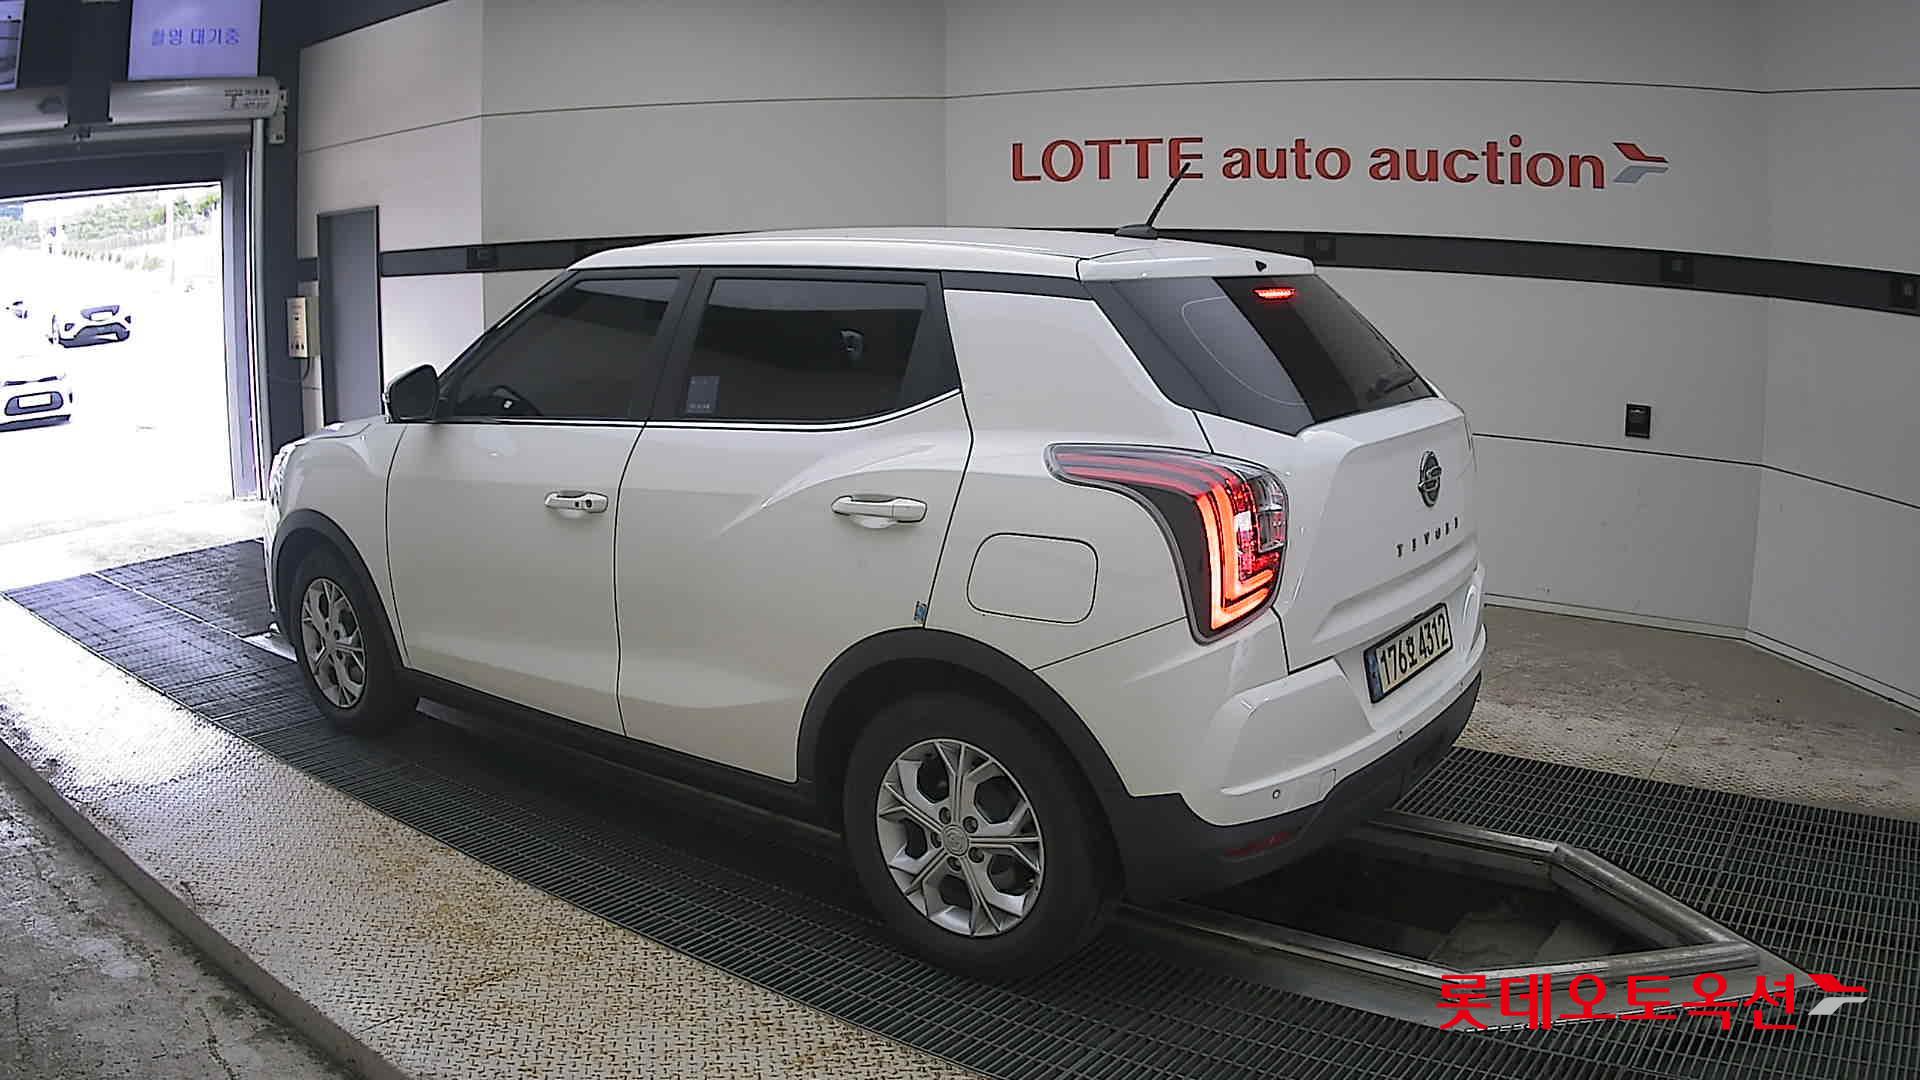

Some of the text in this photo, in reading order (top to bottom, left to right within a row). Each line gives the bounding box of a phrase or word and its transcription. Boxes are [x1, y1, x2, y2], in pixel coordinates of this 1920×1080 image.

[1011, 135, 1605, 189] LOTTE auto auction
[1418, 613, 1449, 659] 4312
